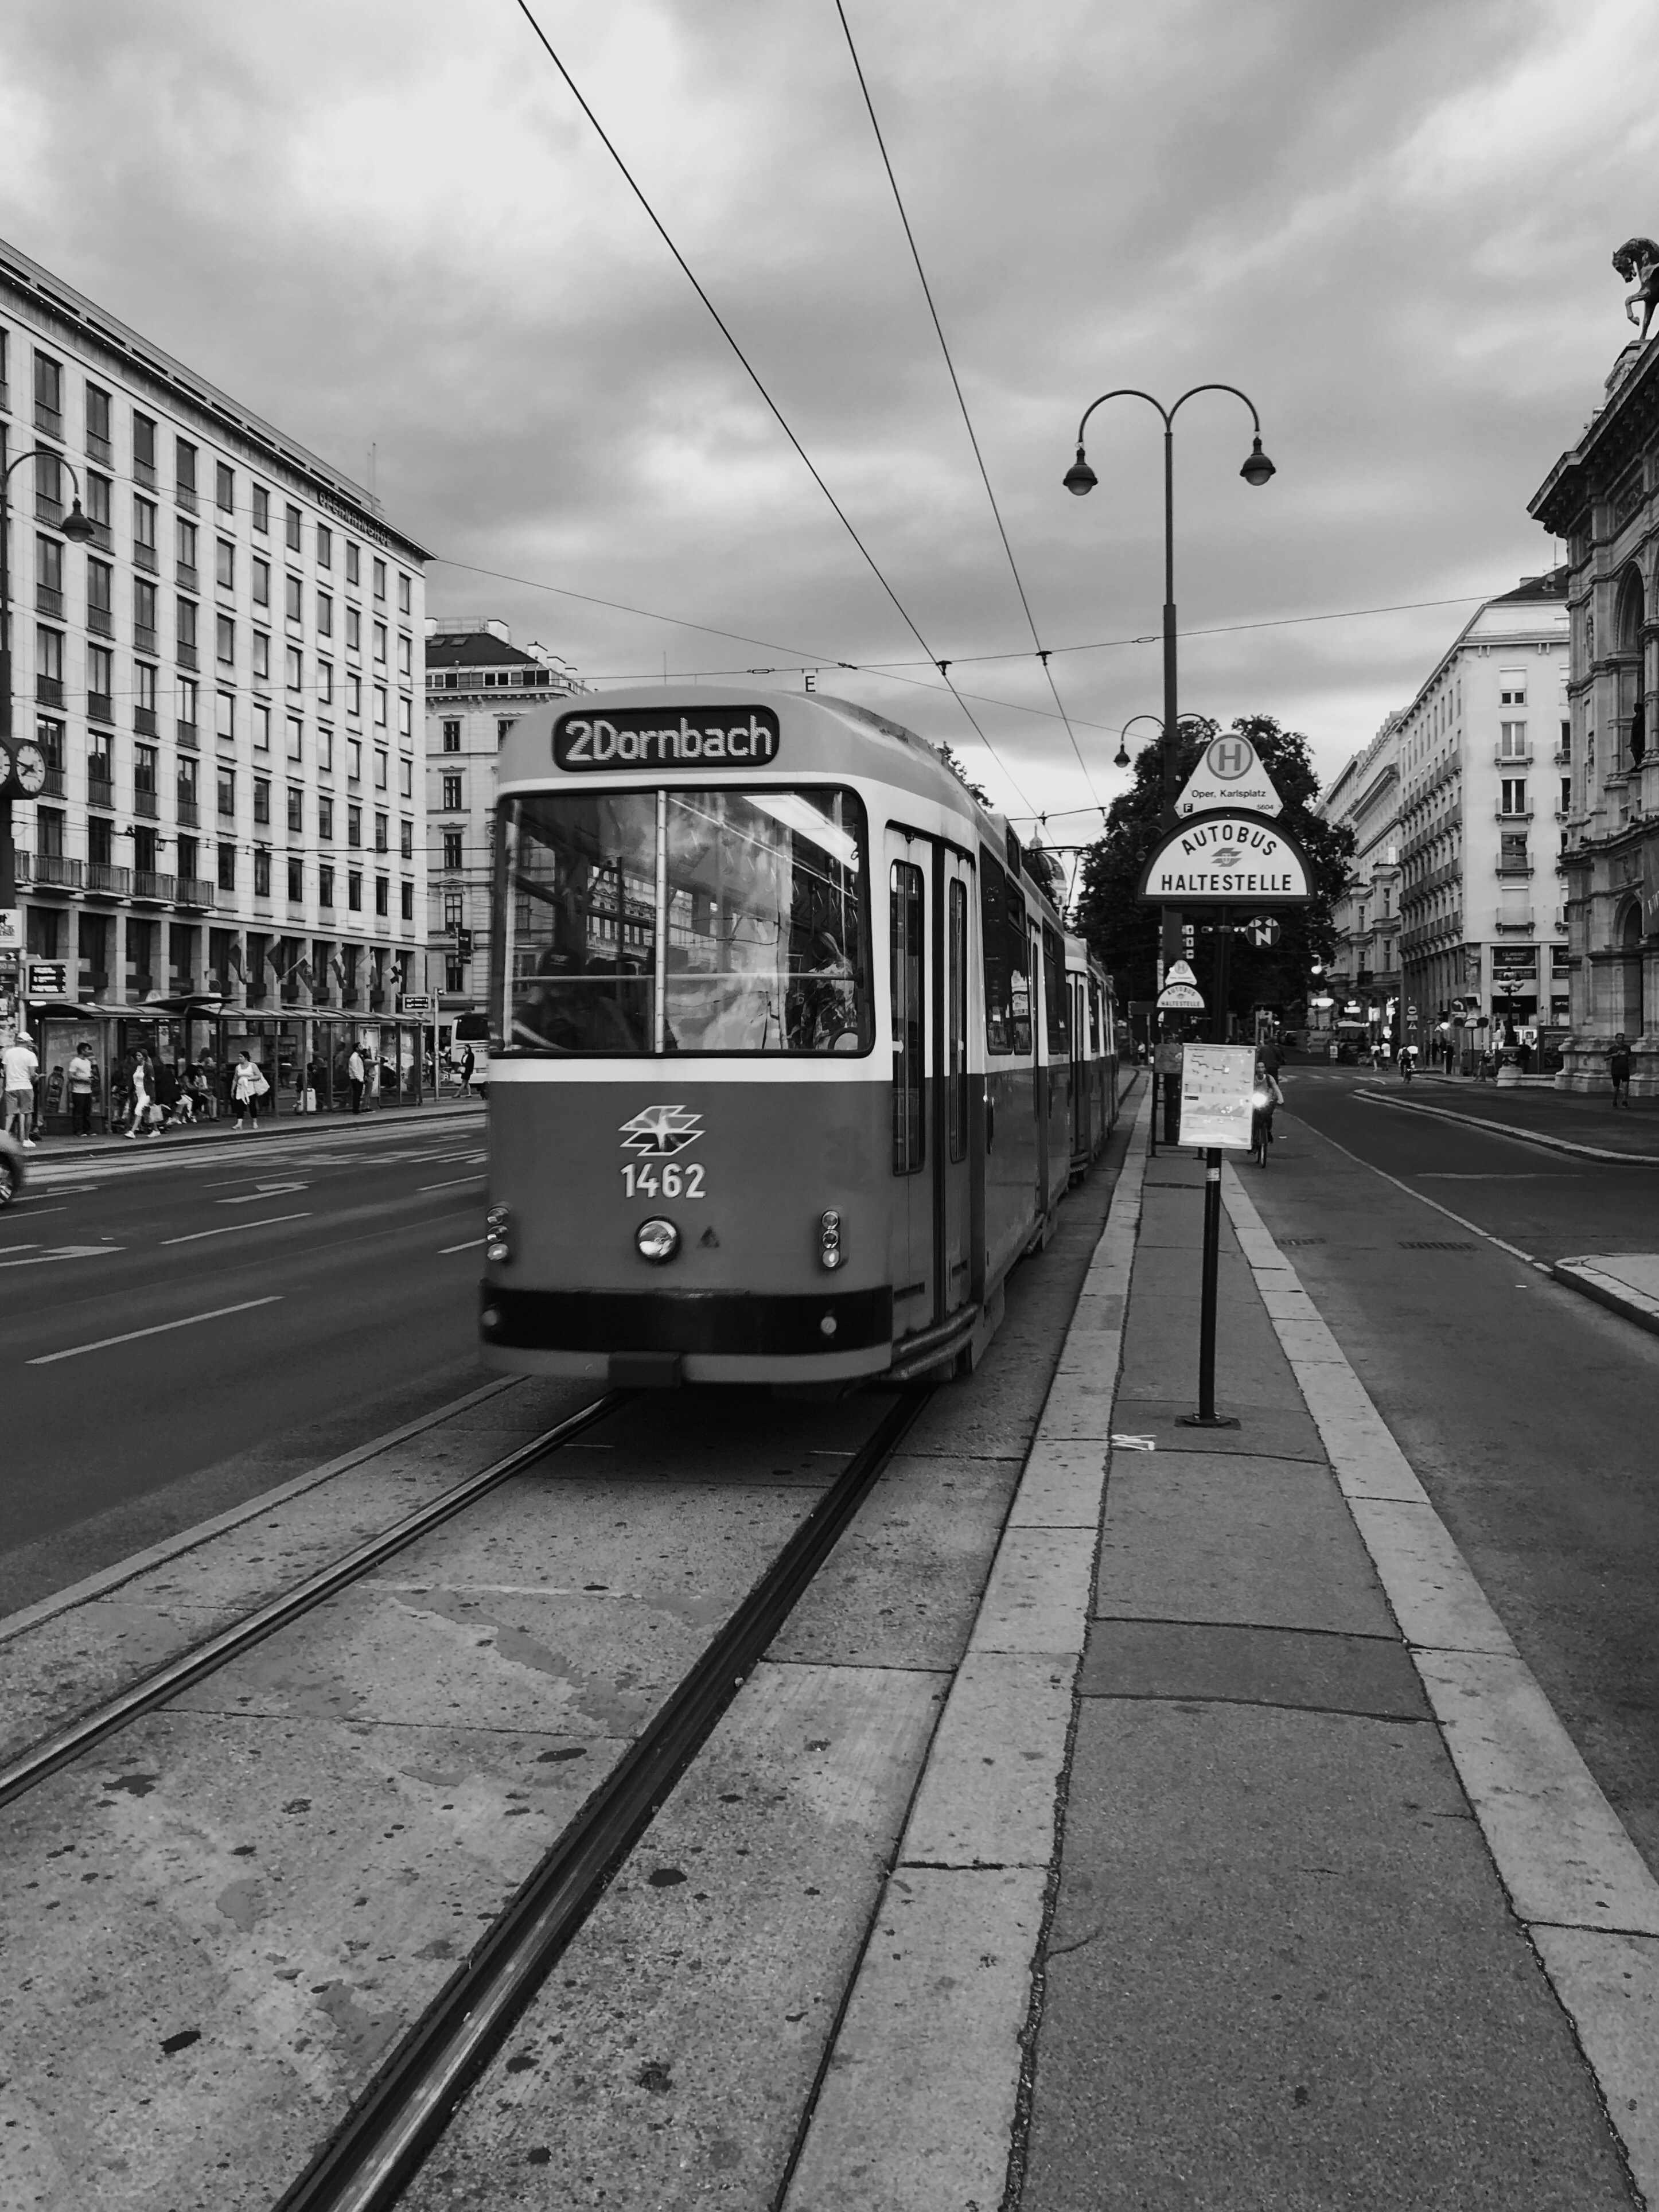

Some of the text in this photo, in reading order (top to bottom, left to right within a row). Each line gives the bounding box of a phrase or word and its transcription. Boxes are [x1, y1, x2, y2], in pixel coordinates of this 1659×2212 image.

[805, 675, 816, 692] E
[1218, 744, 1241, 771] H
[1220, 789, 1266, 799] Karlsplatz
[1181, 824, 1277, 856] AUTOBUS
[1162, 874, 1292, 891] HALTESTELLE
[1255, 927, 1271, 946] N
[620, 1162, 707, 1198] 1462
